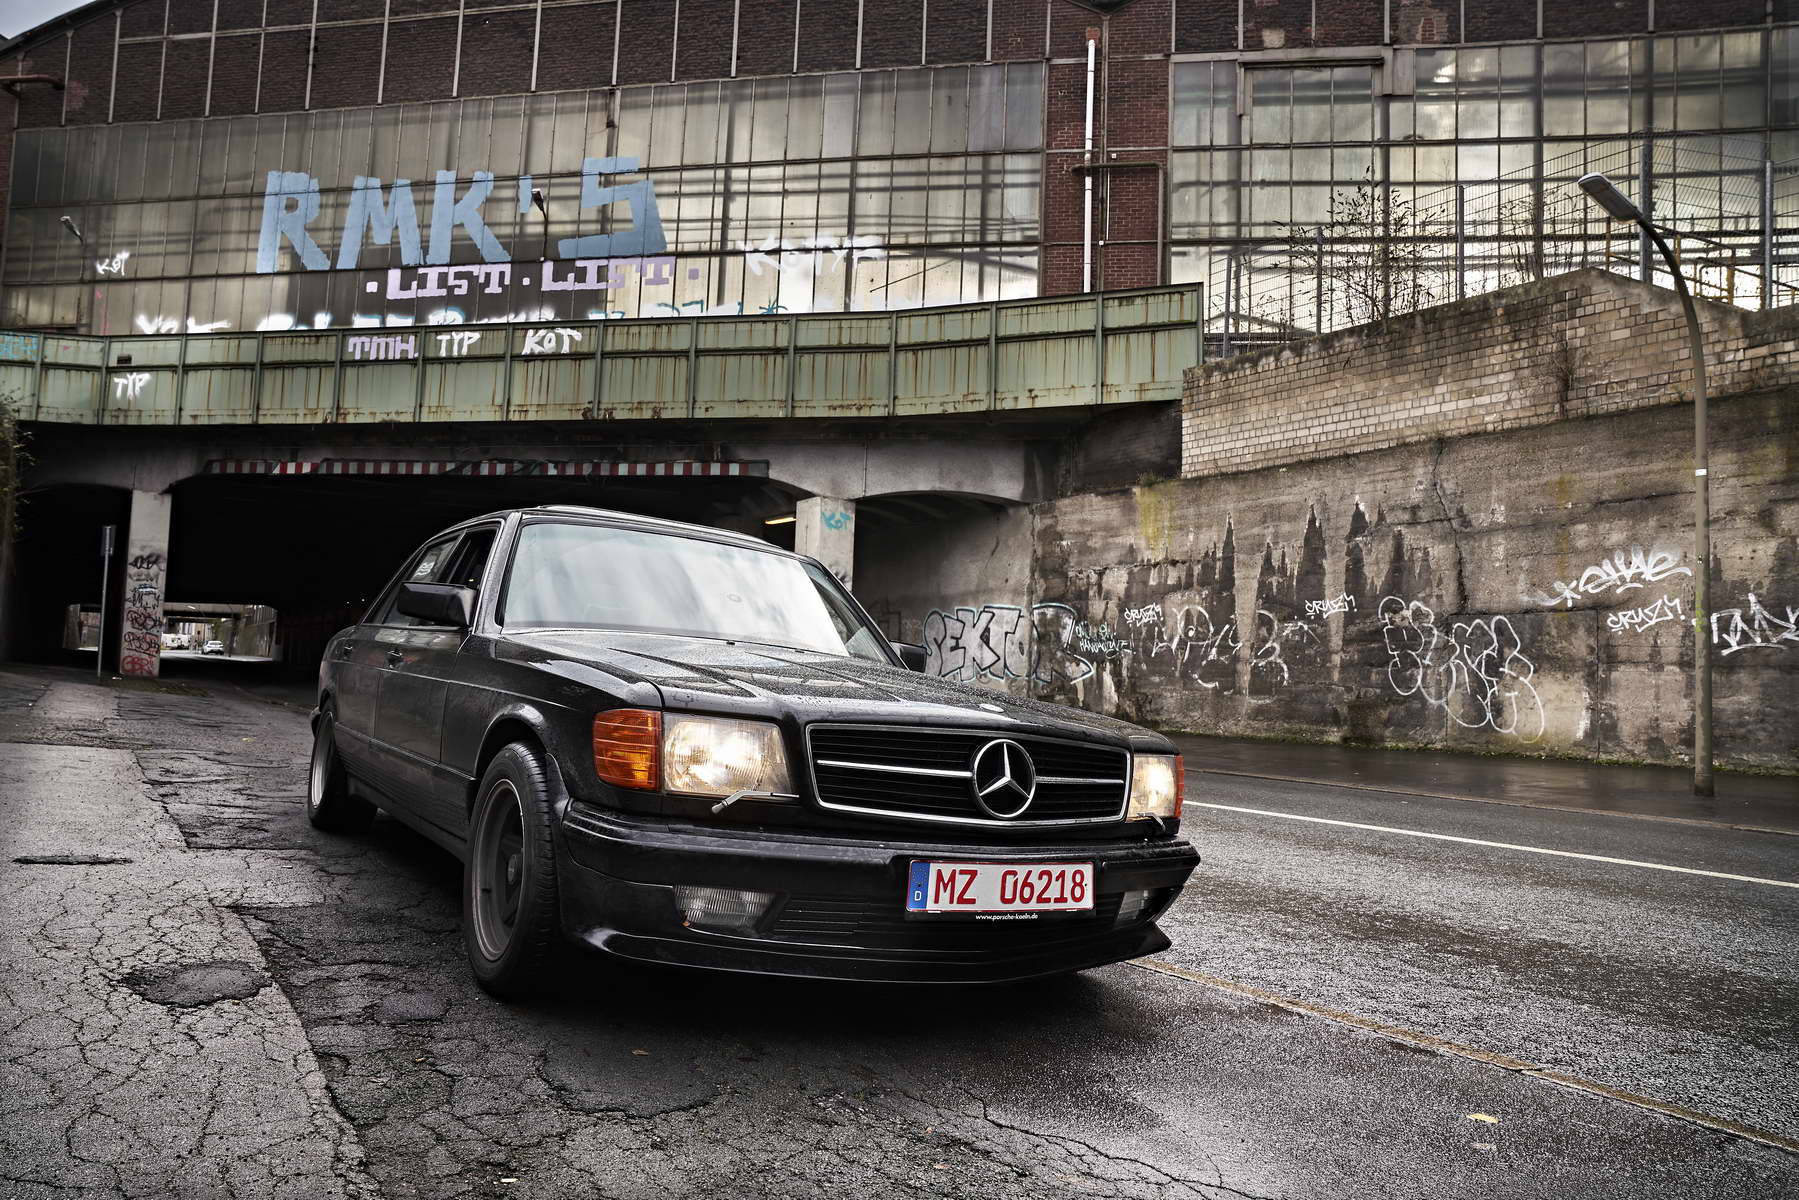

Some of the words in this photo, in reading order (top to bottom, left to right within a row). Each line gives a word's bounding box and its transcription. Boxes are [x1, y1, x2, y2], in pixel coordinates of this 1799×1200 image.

[436, 331, 481, 357] TYP
[521, 328, 583, 355] KOT
[113, 372, 152, 400] TYP
[914, 890, 922, 901] D
[933, 868, 978, 905] MZ
[1000, 868, 1086, 905] 06218
[975, 912, 1039, 921] www.porsche-koeln.de
